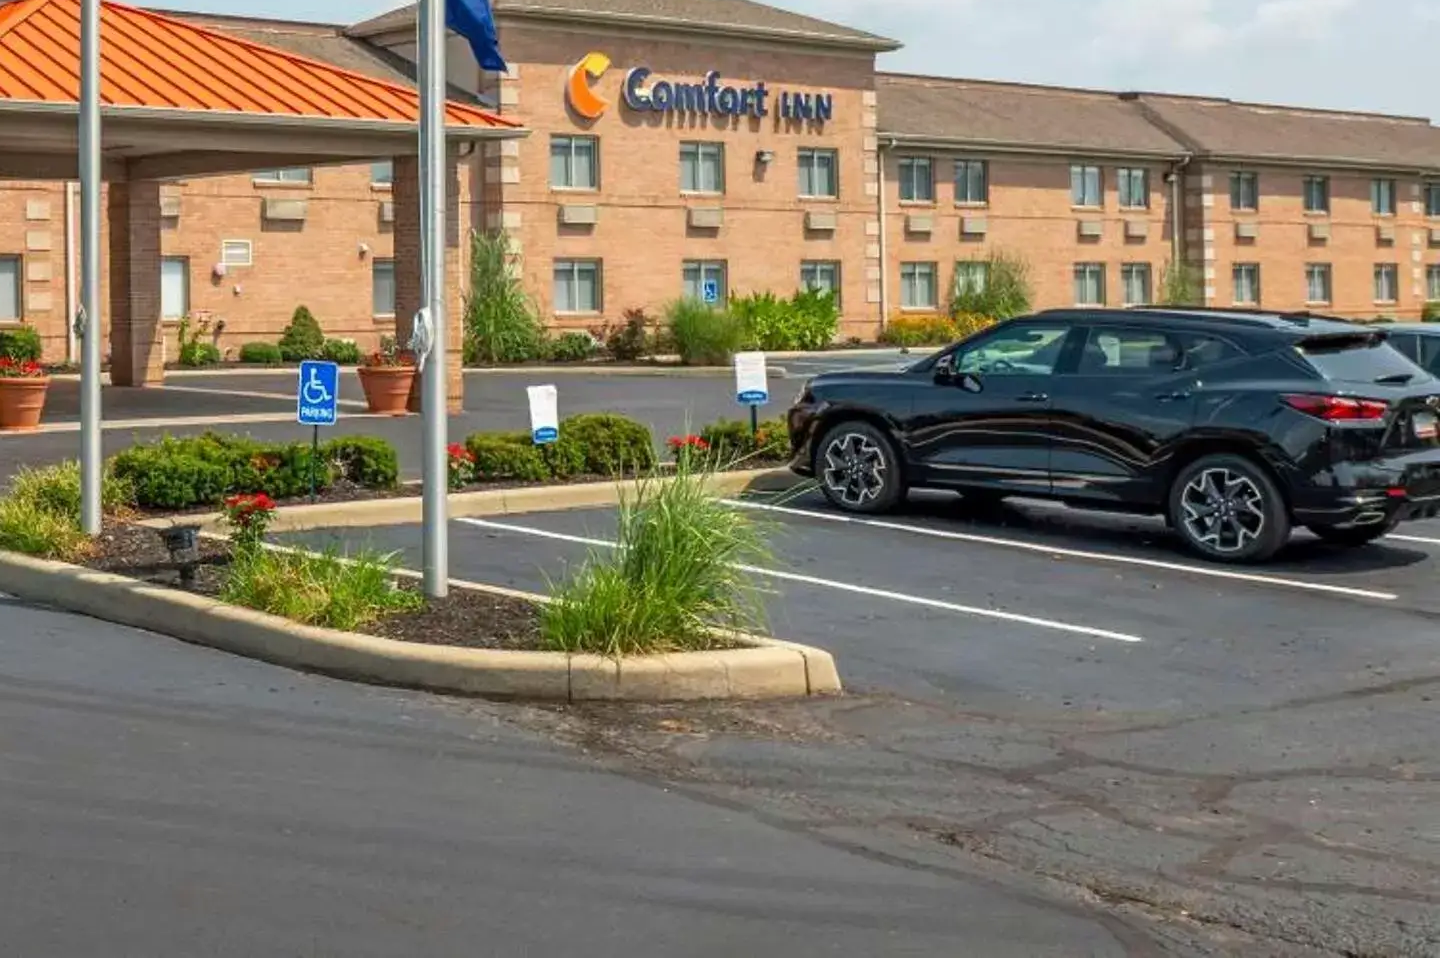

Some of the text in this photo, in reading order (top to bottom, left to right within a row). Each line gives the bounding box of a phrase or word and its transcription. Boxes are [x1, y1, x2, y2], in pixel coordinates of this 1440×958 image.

[625, 66, 832, 120] Comfort INN
[301, 406, 333, 419] PARKING
